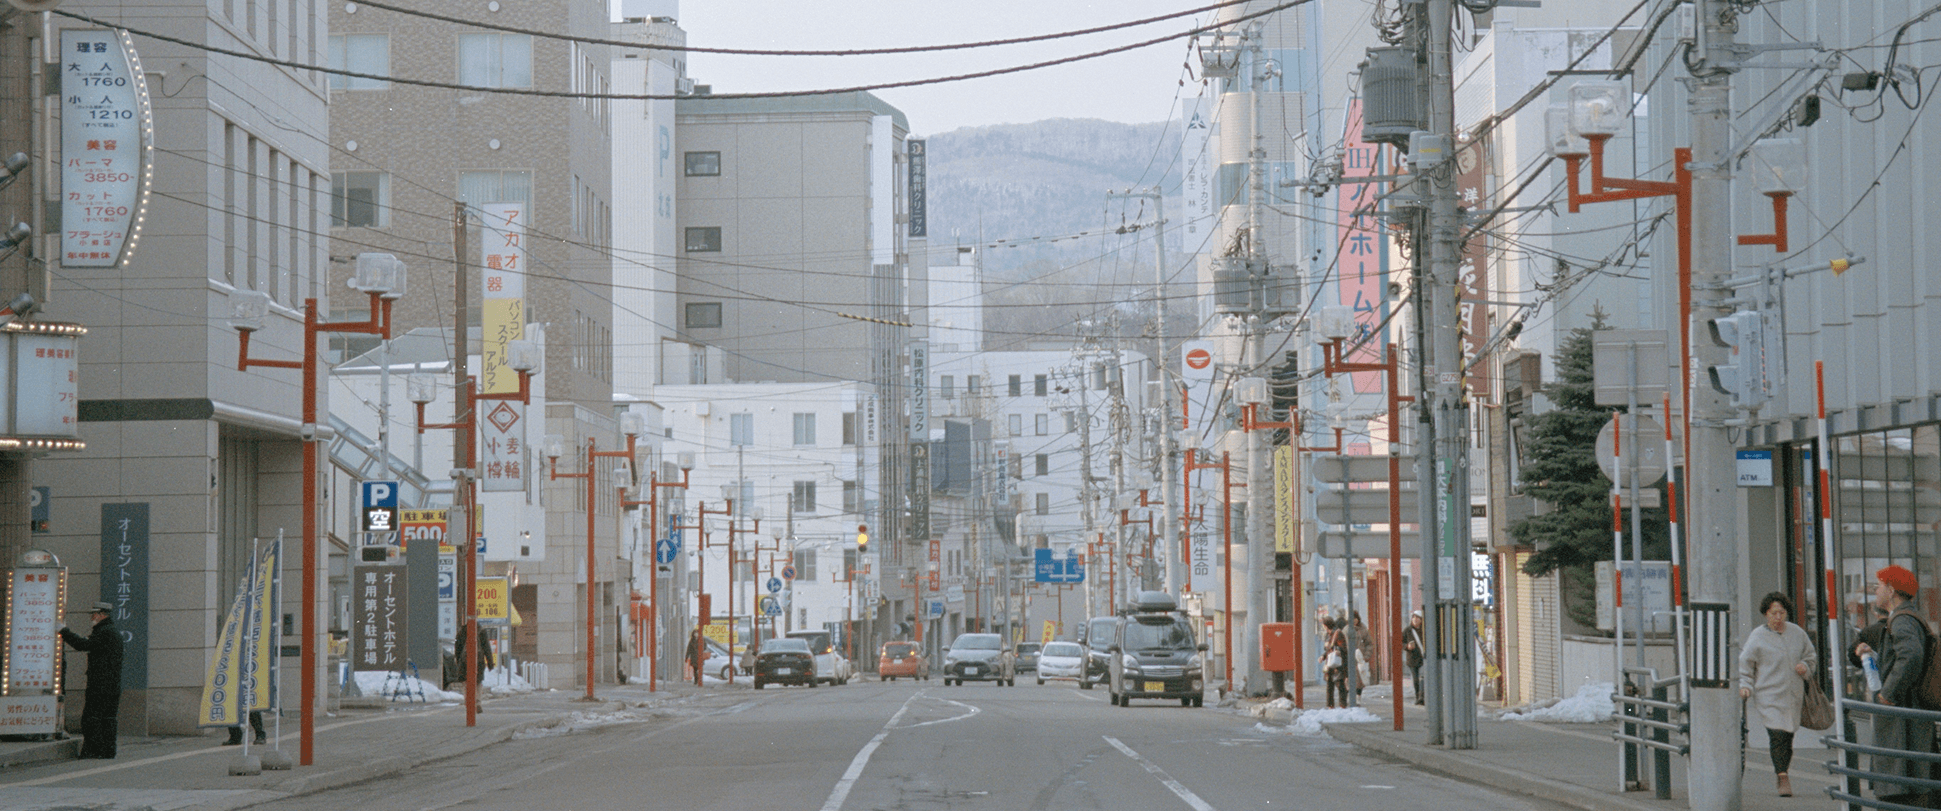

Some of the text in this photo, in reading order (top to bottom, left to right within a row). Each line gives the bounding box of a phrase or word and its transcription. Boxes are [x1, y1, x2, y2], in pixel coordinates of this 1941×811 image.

[77, 42, 108, 53] 理容
[68, 63, 113, 71] 大人
[82, 77, 126, 87] 1760
[68, 95, 113, 104] 小人
[90, 110, 133, 120] 1210
[87, 139, 117, 150] 美容
[68, 158, 113, 168] パーマ
[68, 192, 113, 201] カット
[84, 206, 128, 216] 1760
[67, 231, 122, 239] フラージュ
[504, 210, 520, 270] アカオ
[486, 254, 503, 292] 電器
[509, 300, 520, 341] パソコン
[498, 324, 509, 367] スクール
[485, 351, 497, 390] アルファ
[370, 483, 390, 506] P
[369, 508, 391, 530] 空
[399, 511, 447, 521] 駐車場
[117, 518, 132, 620] オーセントホテル
[364, 571, 378, 665] 専用第2駐車場
[383, 571, 397, 664] オーセントホテル
